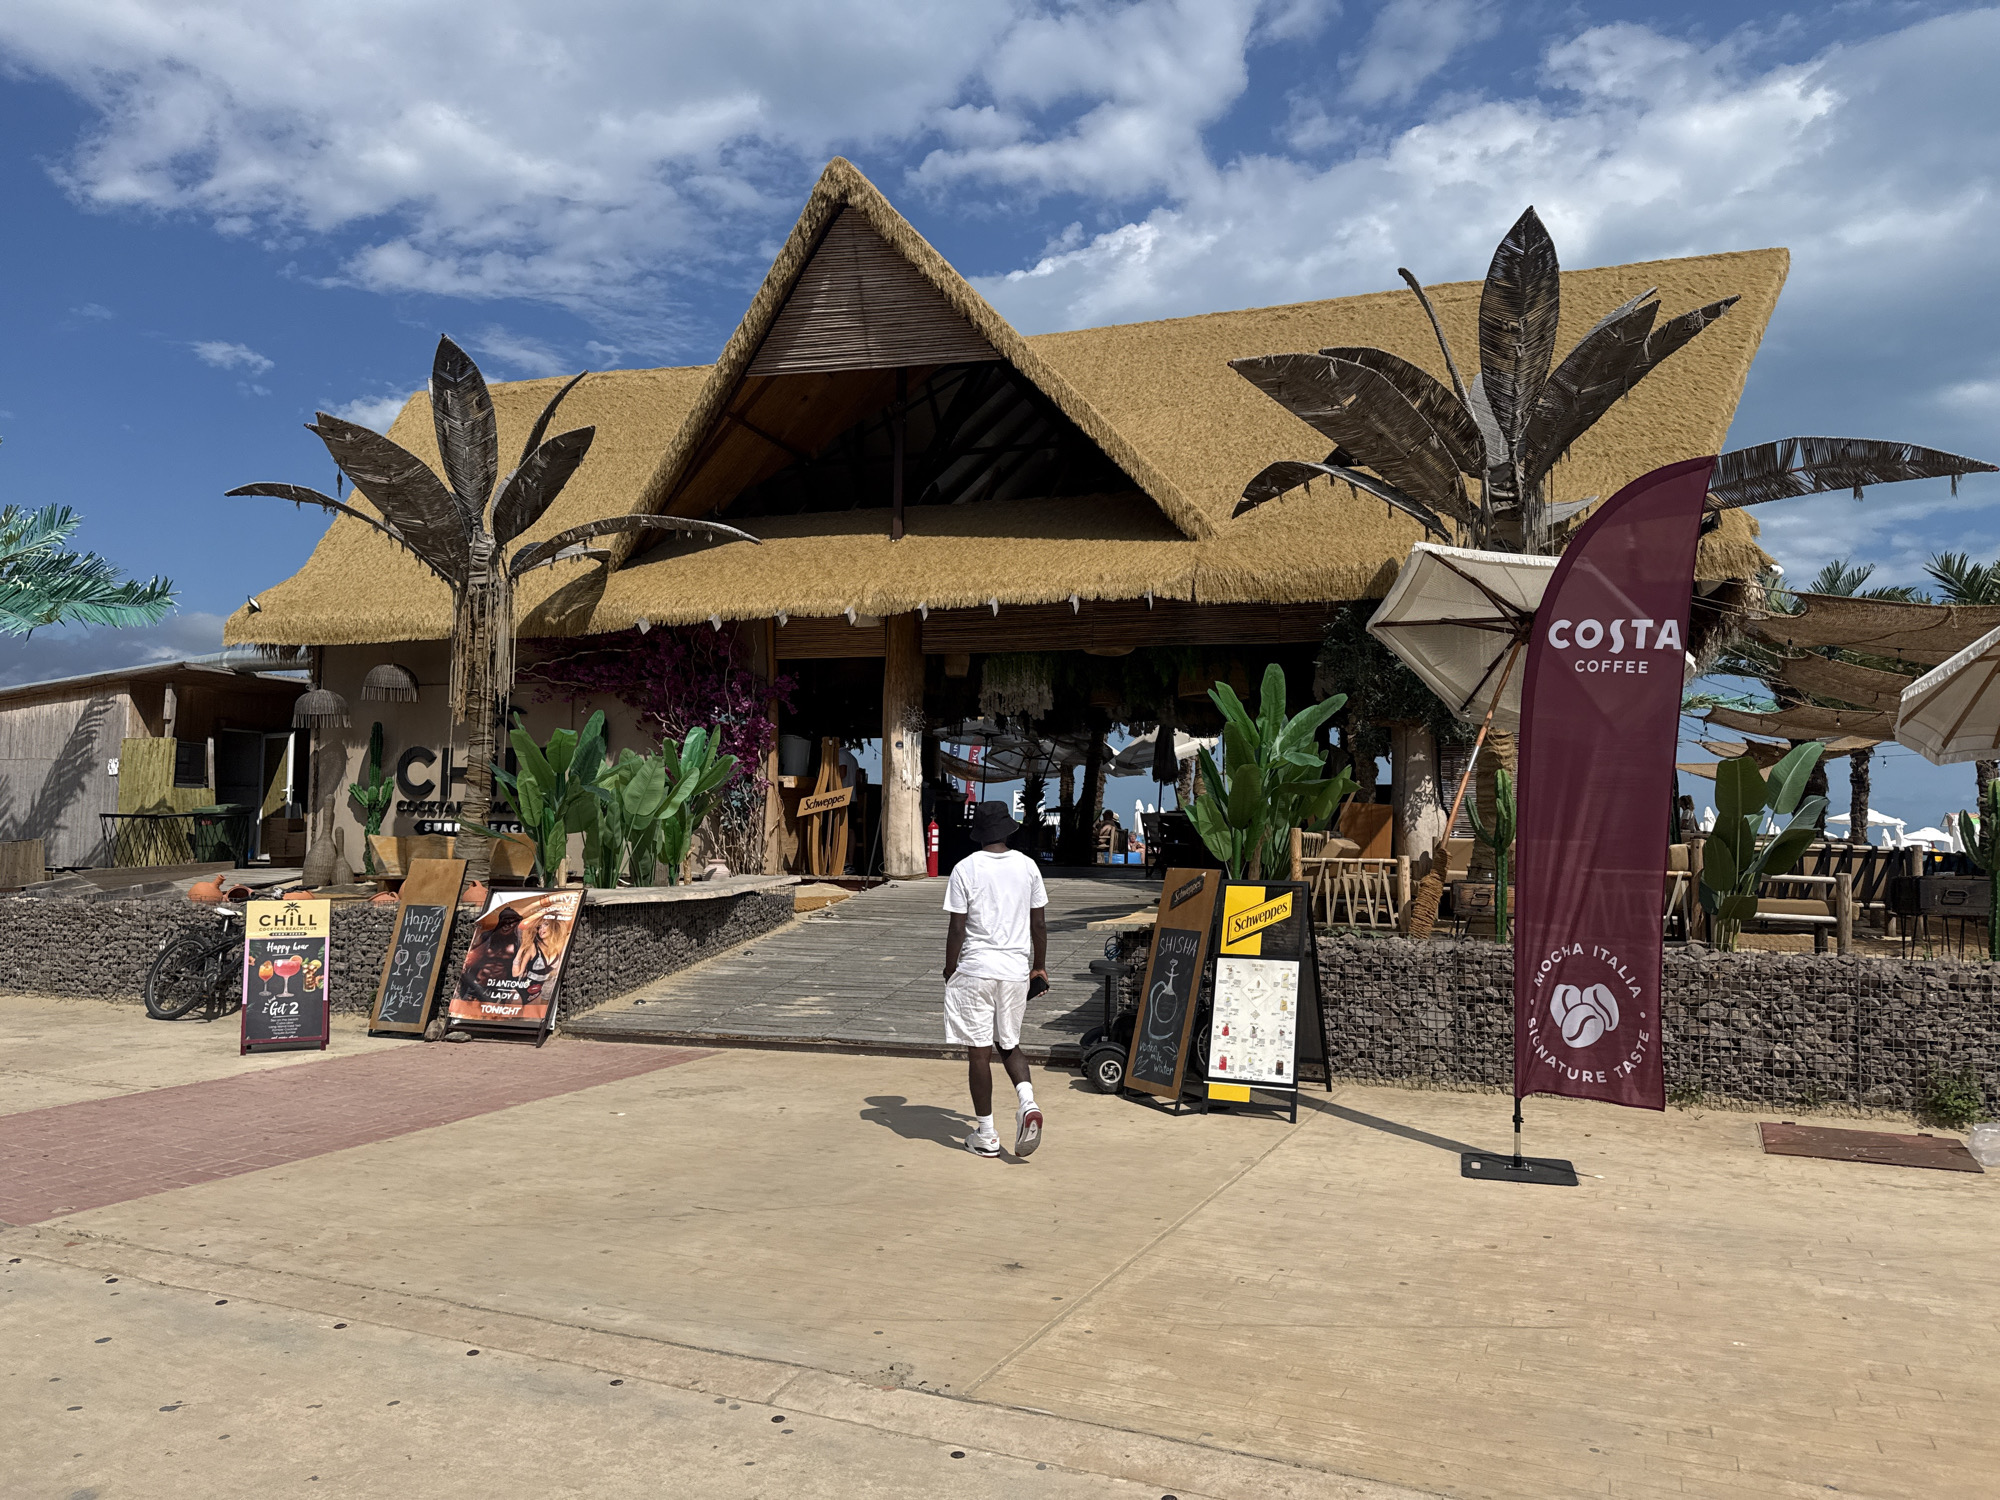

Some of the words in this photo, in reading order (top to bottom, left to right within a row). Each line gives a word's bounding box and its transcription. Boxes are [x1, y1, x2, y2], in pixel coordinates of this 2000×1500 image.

[1548, 618, 1682, 654] COSTA
[1574, 659, 1649, 674] COFFEE
[804, 794, 845, 811] Schweppes
[424, 822, 462, 832] SUNN
[1174, 880, 1201, 902] Schweppes
[404, 908, 441, 933] Happy
[1234, 902, 1288, 933] Schweppes
[403, 927, 434, 946] hour!
[266, 941, 291, 955] Happy
[1159, 936, 1198, 958] SHISHA
[1533, 942, 1584, 987] MOCHA
[1593, 945, 1642, 999] ITALIA
[390, 980, 404, 995] buy
[406, 977, 414, 994] 1
[398, 991, 414, 1008] get
[412, 992, 423, 1007] 2
[490, 991, 514, 999] LADY
[513, 992, 520, 1000] B
[269, 1001, 289, 1016] Get
[289, 1001, 299, 1015] 2
[480, 1004, 522, 1016] TONIGHT
[1528, 1017, 1608, 1084] SIGNATURE
[1613, 1028, 1650, 1079] TASTE
